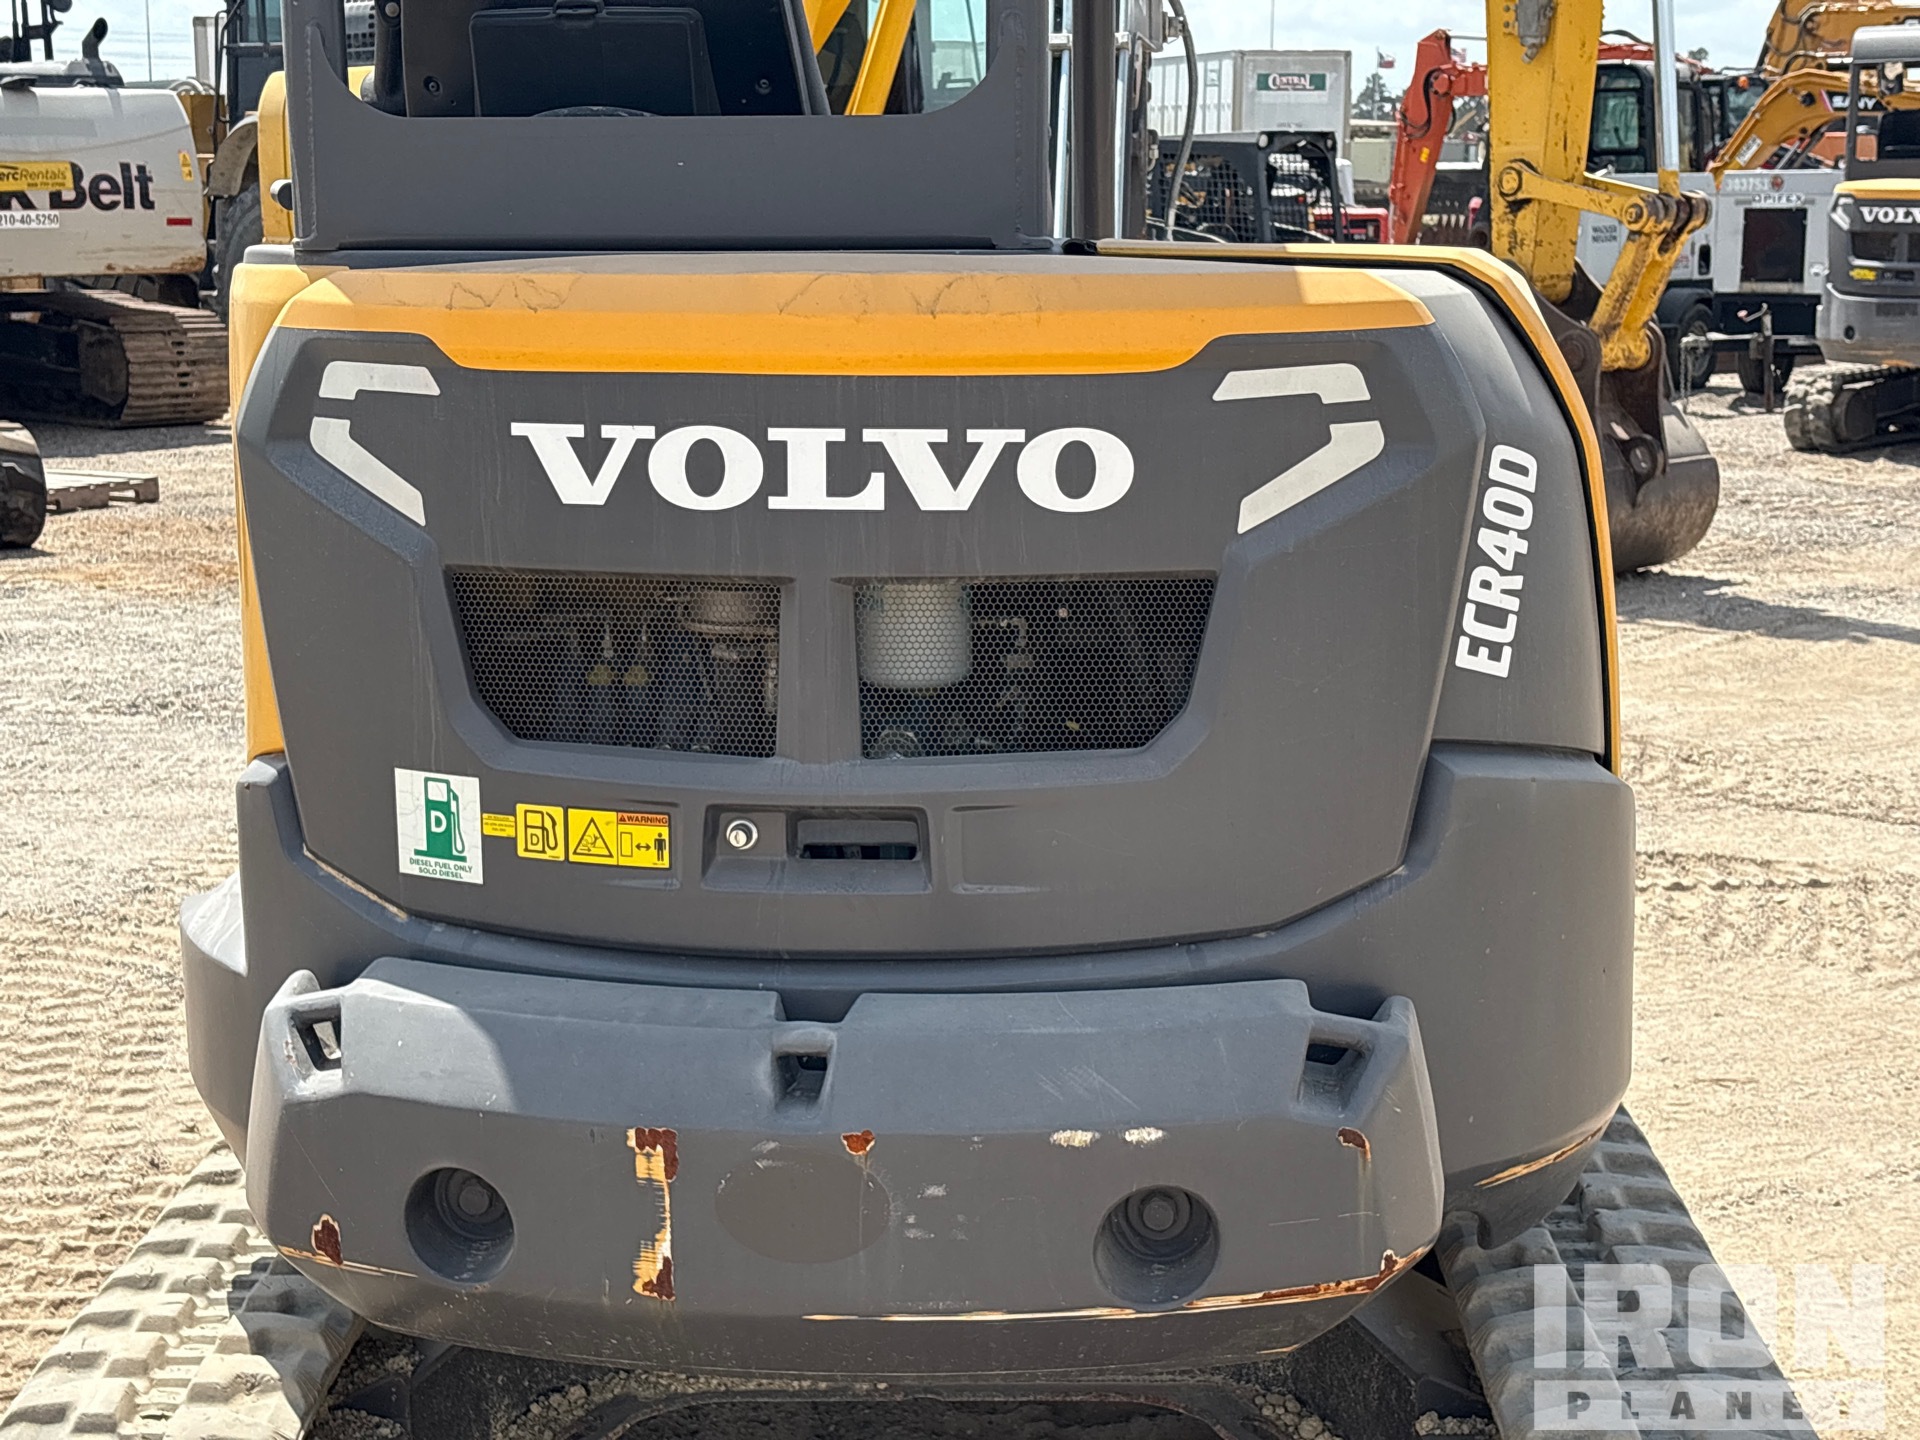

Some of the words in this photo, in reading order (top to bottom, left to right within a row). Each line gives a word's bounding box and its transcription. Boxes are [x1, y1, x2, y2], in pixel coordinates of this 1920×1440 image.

[510, 421, 1135, 513] VOLVO
[1455, 444, 1538, 678] ECR40D
[430, 810, 448, 834] D
[626, 814, 668, 825] WARNING
[530, 832, 540, 847] D
[409, 857, 433, 868] DIESEL
[434, 861, 452, 870] FUEL
[453, 863, 473, 874] ONLY
[418, 866, 438, 876] SOLO
[439, 869, 464, 879] DIESEL
